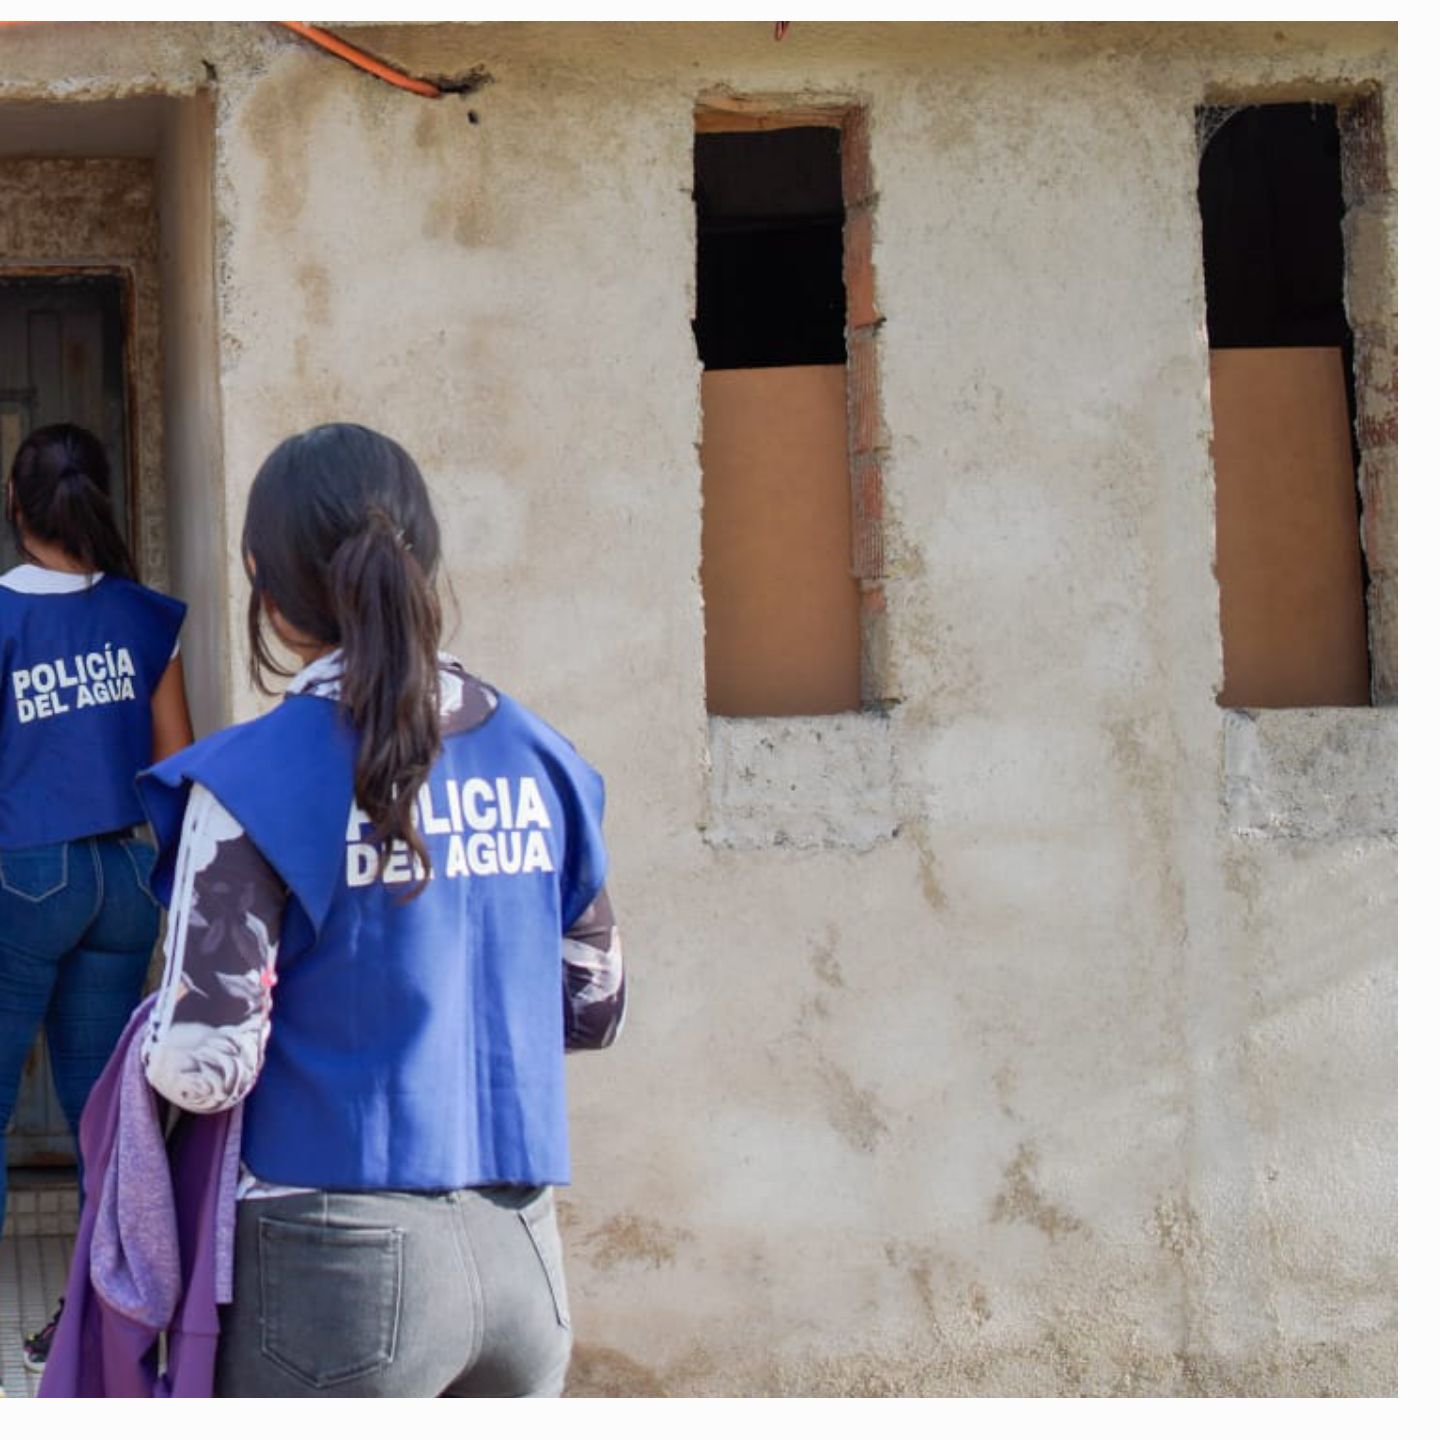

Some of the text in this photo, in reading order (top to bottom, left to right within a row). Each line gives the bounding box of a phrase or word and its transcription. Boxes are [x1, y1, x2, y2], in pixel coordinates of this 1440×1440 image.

[12, 643, 136, 699] POLICÍA
[17, 677, 136, 723] DEL AGUA
[346, 776, 551, 841] LICIA
[446, 830, 554, 878] AGUA
